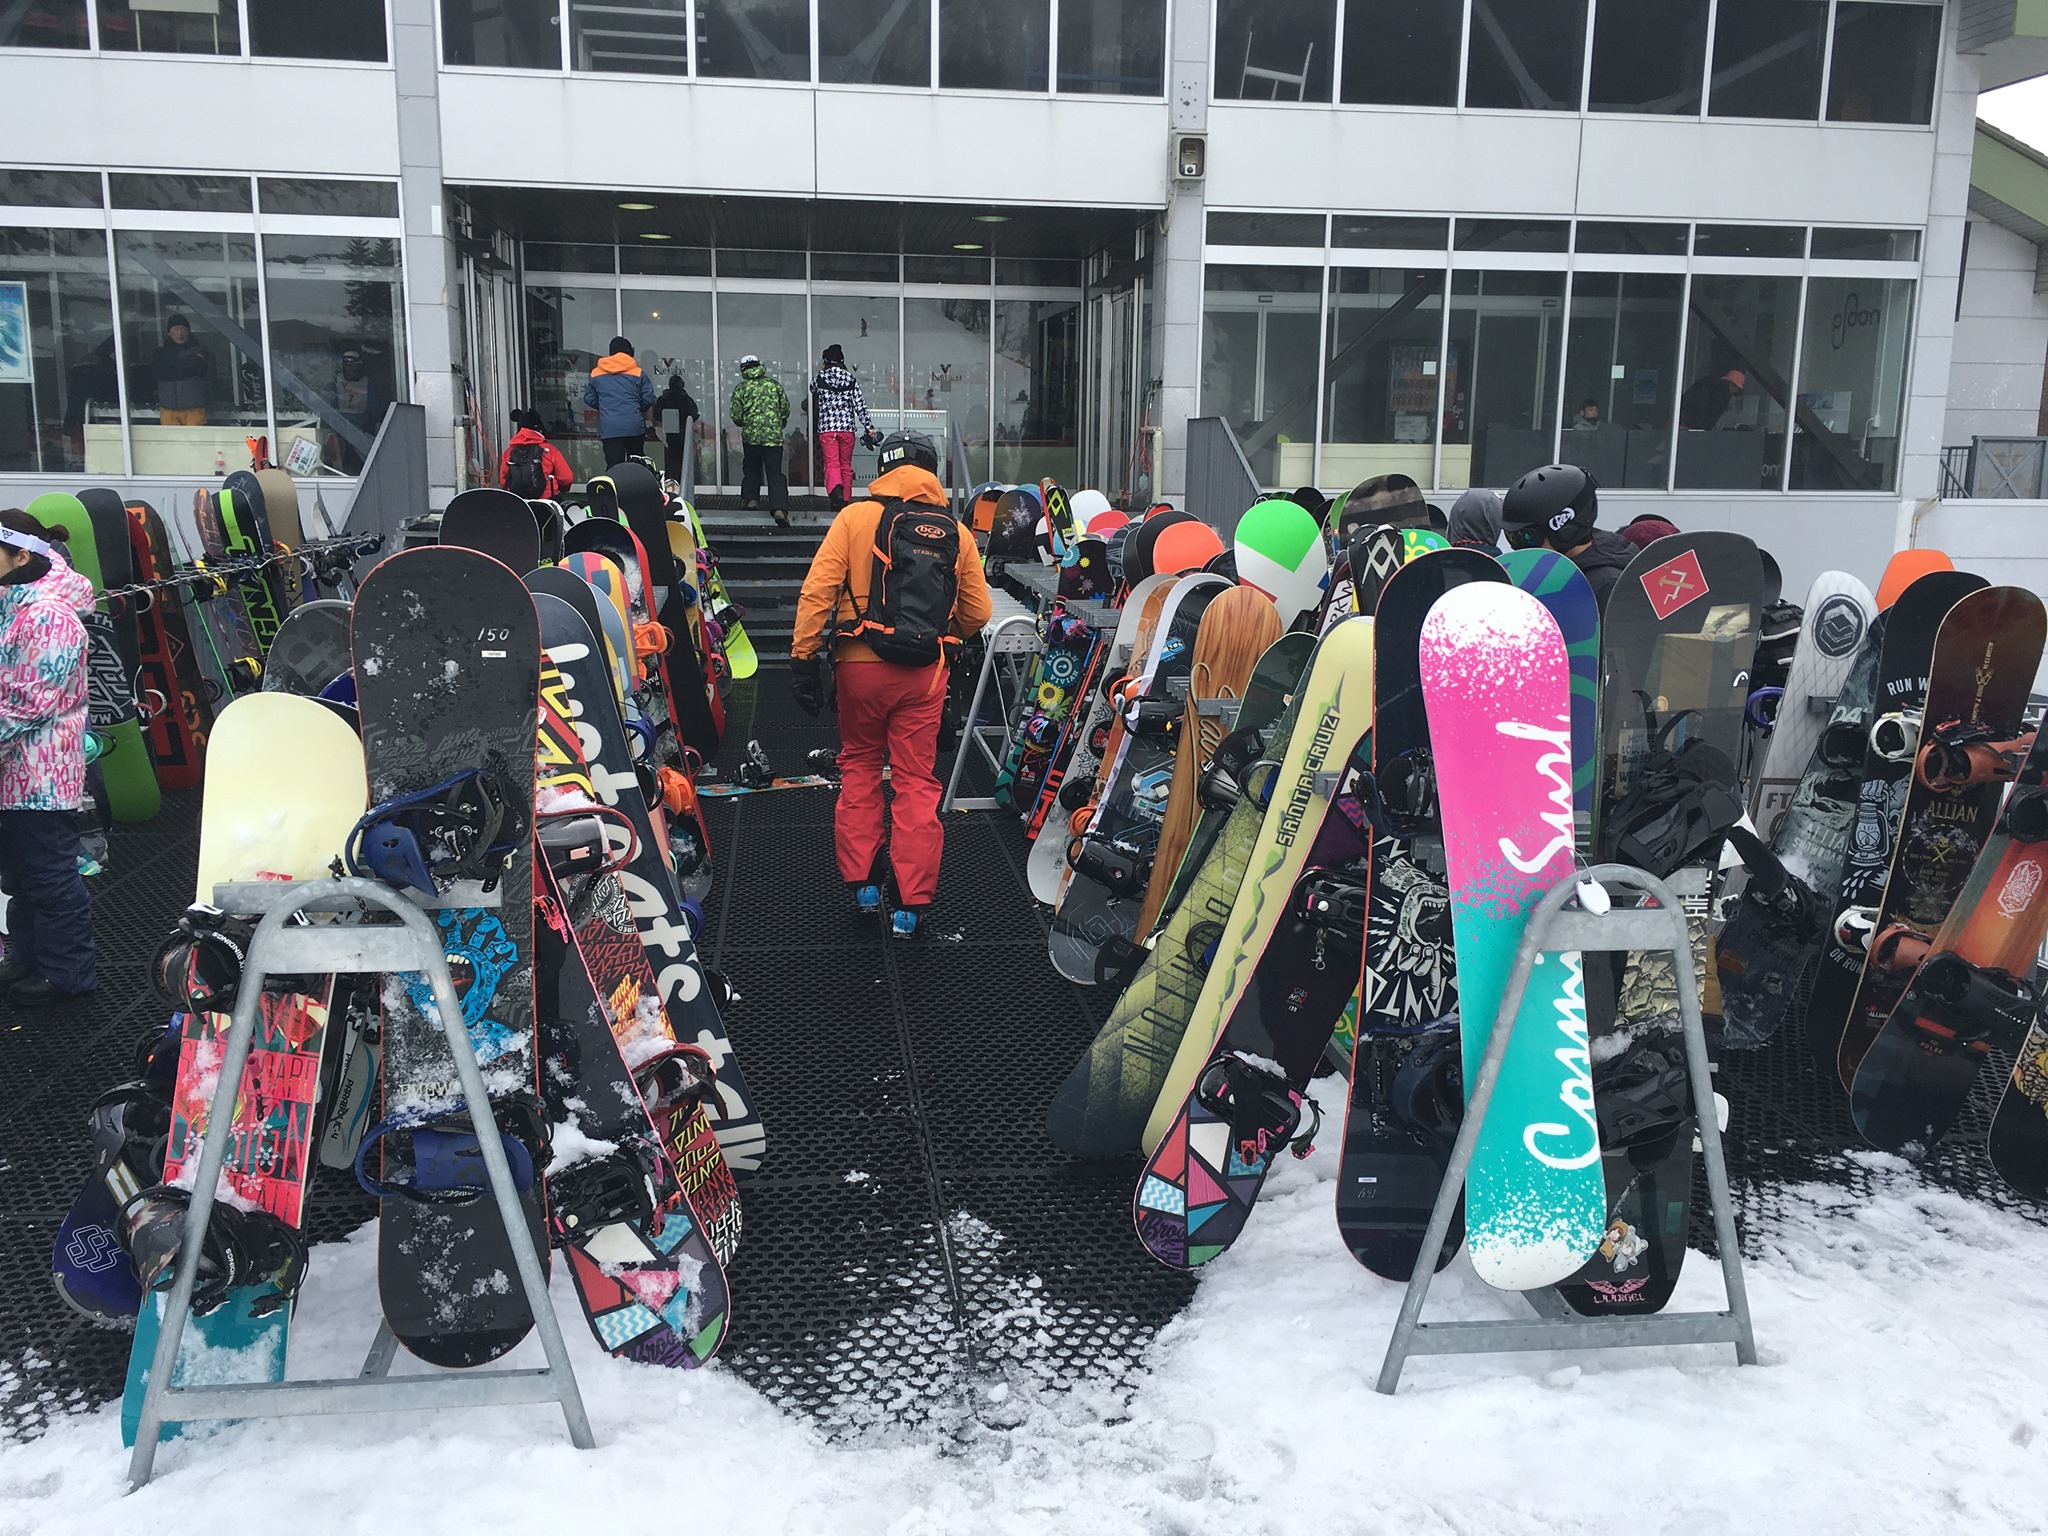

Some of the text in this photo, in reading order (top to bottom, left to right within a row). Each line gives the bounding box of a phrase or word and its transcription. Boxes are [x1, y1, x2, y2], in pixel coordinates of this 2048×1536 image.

[920, 525, 941, 535] bca
[477, 627, 510, 642] 150
[1046, 649, 1079, 666] ALLIAN
[1887, 677, 1913, 696] RUN
[1275, 713, 1341, 848] SANTA CRUZ
[1925, 800, 1979, 823] ALLIAN
[212, 929, 244, 961] BINDINGS
[1829, 948, 1844, 964] OR
